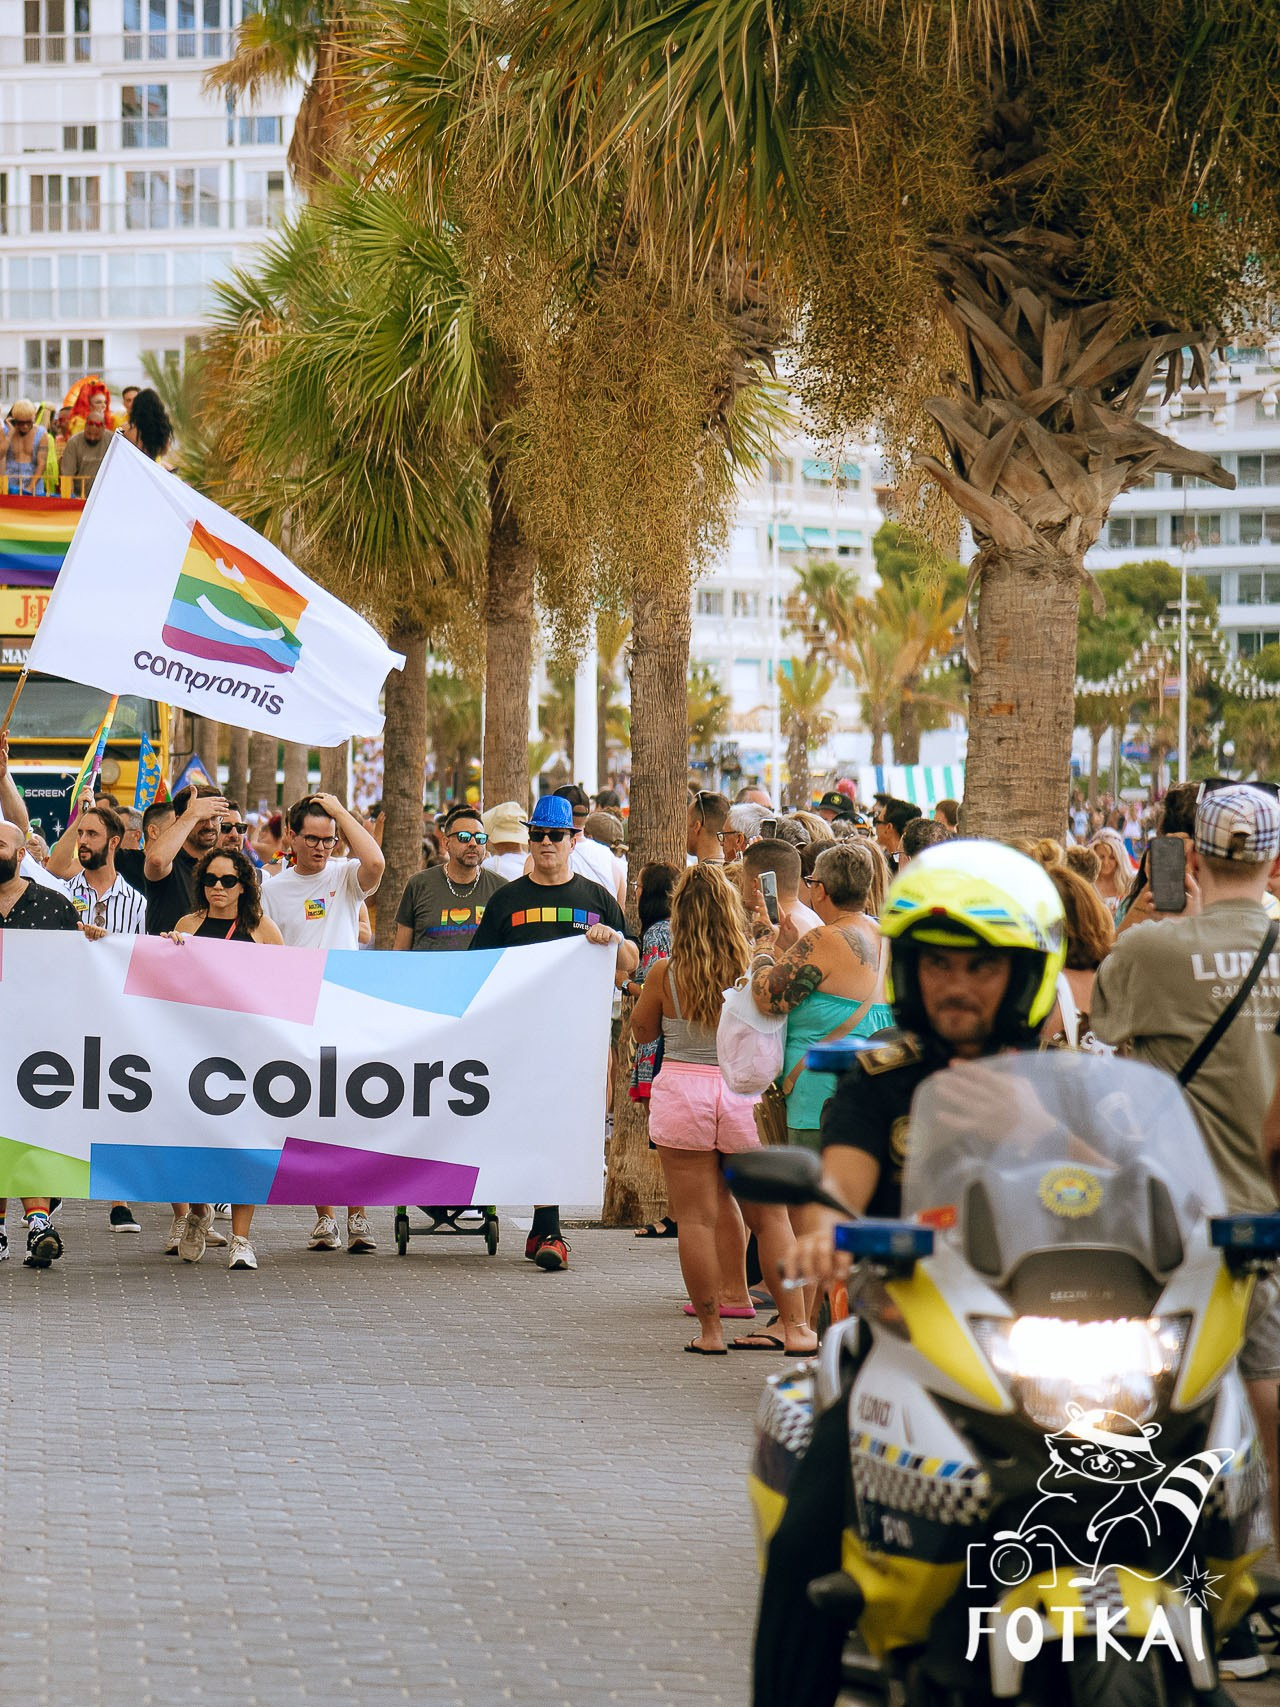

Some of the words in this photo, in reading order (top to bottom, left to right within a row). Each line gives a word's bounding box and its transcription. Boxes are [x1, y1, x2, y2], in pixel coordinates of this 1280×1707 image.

[24, 789, 66, 798] SCREEN
[16, 1035, 153, 1113] els
[188, 1046, 490, 1119] colors
